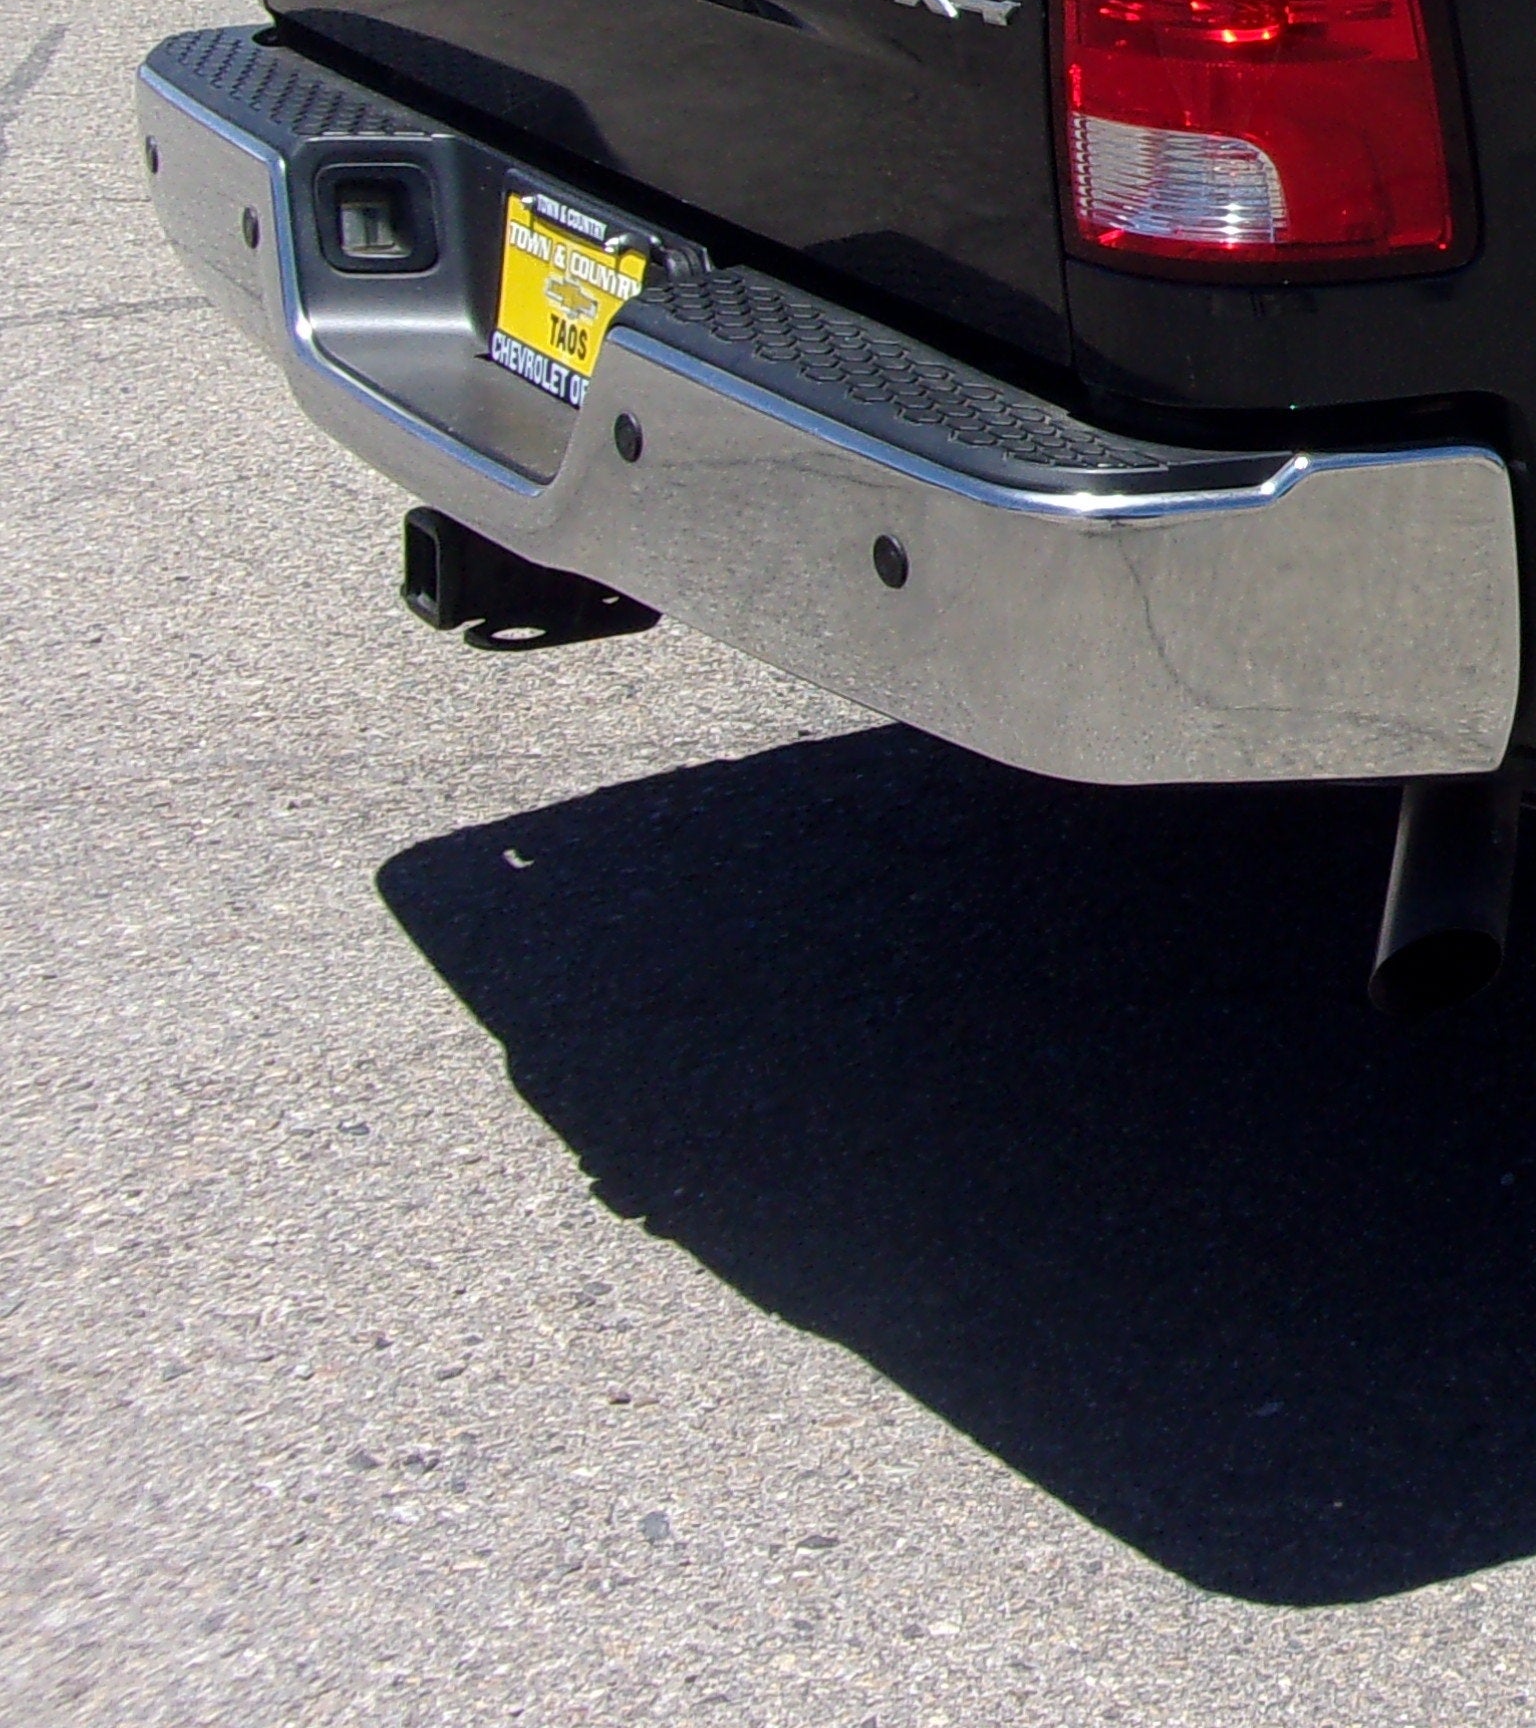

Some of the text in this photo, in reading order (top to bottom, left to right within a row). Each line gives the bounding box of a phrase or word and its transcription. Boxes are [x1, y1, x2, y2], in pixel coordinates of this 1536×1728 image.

[509, 221, 643, 301] TOWN & COUNTRY
[491, 330, 590, 407] CHEVROLET OF
[550, 313, 588, 361] TAOS
